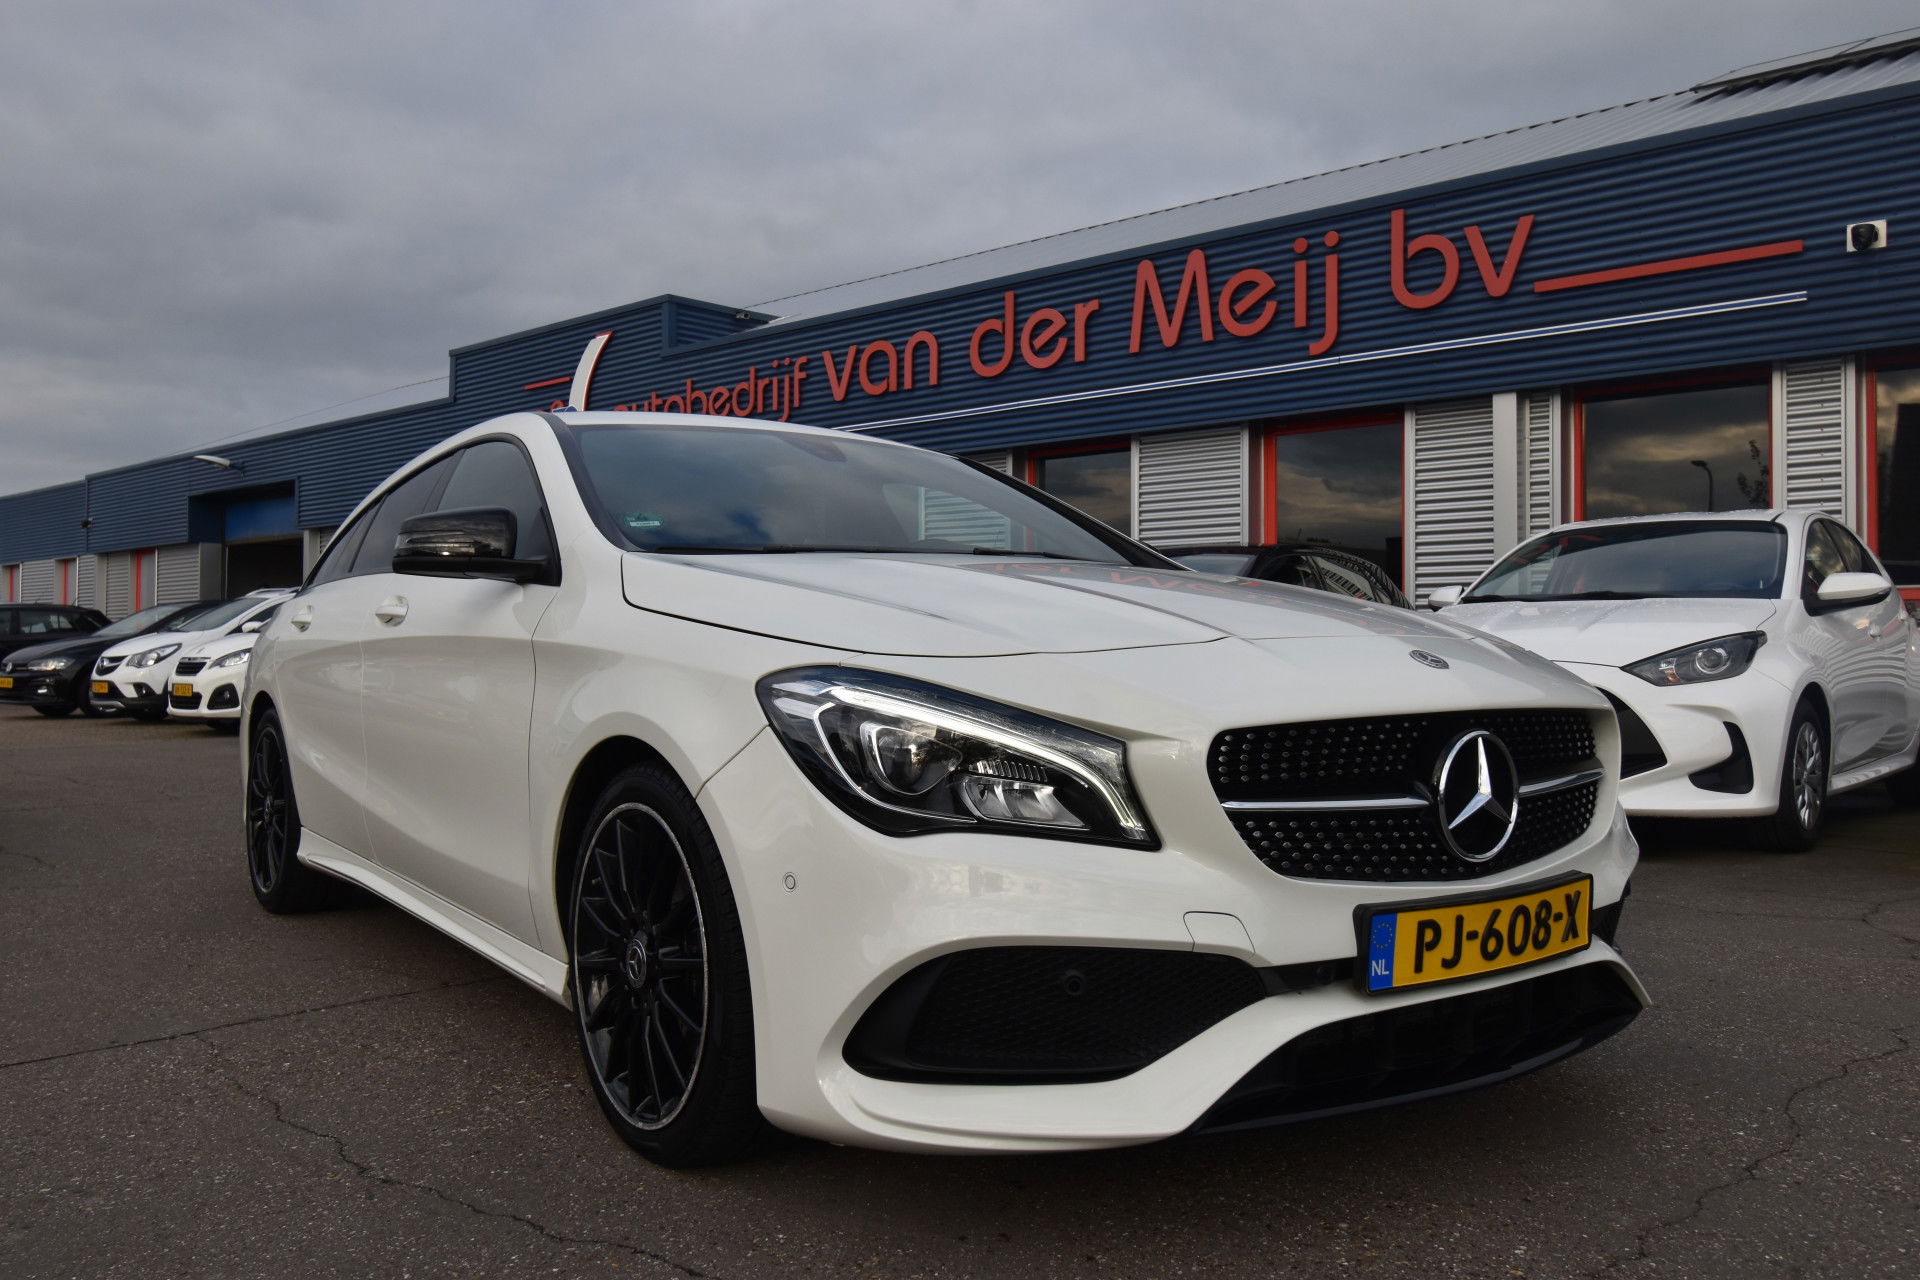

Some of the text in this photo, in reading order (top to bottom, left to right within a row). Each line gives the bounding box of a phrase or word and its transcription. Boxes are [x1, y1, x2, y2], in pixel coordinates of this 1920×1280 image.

[613, 209, 1535, 422] tobedrijf van der Meij bv
[1371, 890, 1581, 976] NL PJ-608-X
